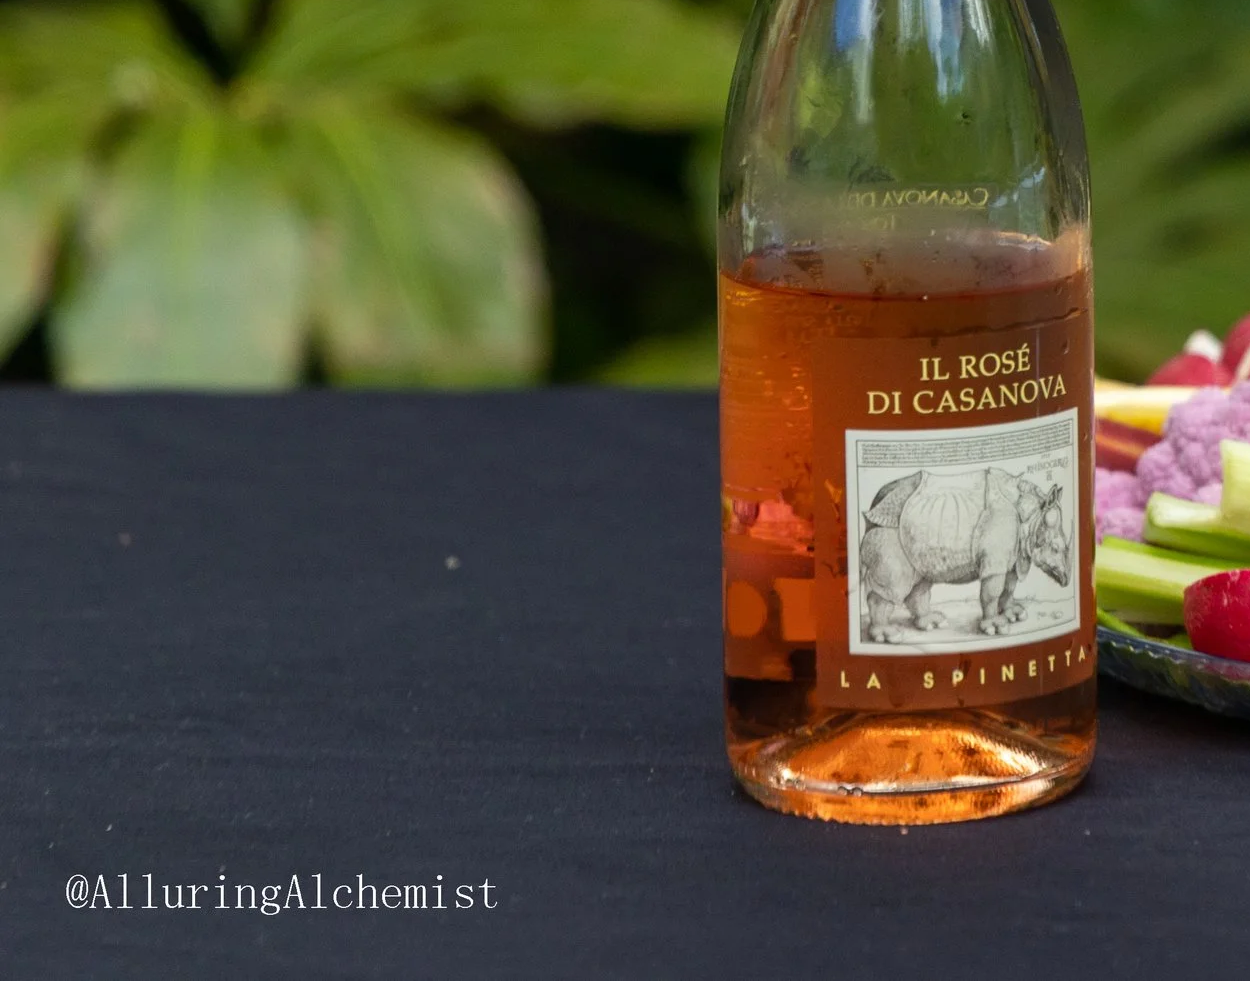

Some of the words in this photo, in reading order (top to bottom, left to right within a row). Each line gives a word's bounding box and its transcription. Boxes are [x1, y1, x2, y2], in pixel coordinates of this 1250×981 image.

[920, 357, 950, 381] IL
[959, 343, 1031, 380] ROSÉ
[867, 391, 902, 415] DI
[912, 374, 1067, 415] CASANOVA
[840, 670, 881, 690] LA
[923, 645, 1087, 690] SPINETTA
